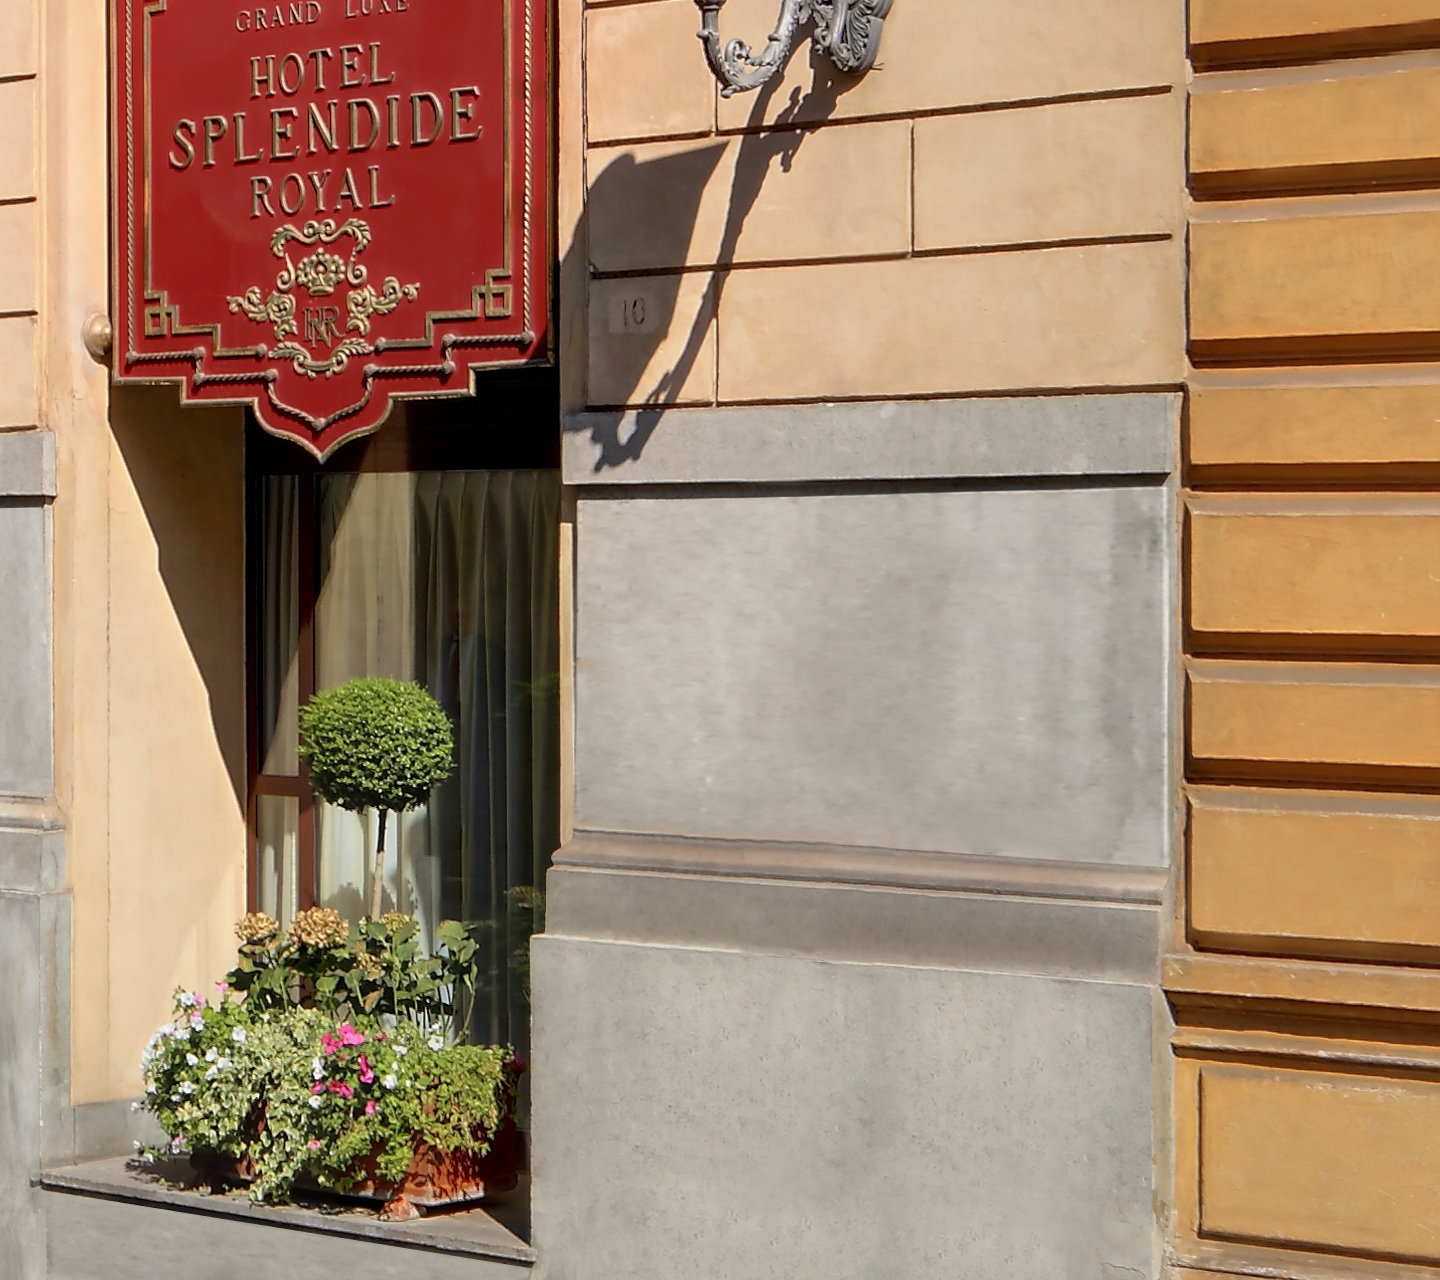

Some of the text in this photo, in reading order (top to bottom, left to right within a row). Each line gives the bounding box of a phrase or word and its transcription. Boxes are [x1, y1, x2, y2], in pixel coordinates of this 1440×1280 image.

[236, 0, 322, 31] GRAND
[250, 42, 396, 98] HOTEL
[169, 86, 483, 169] SPLENDIDE
[250, 165, 396, 217] ROYAL
